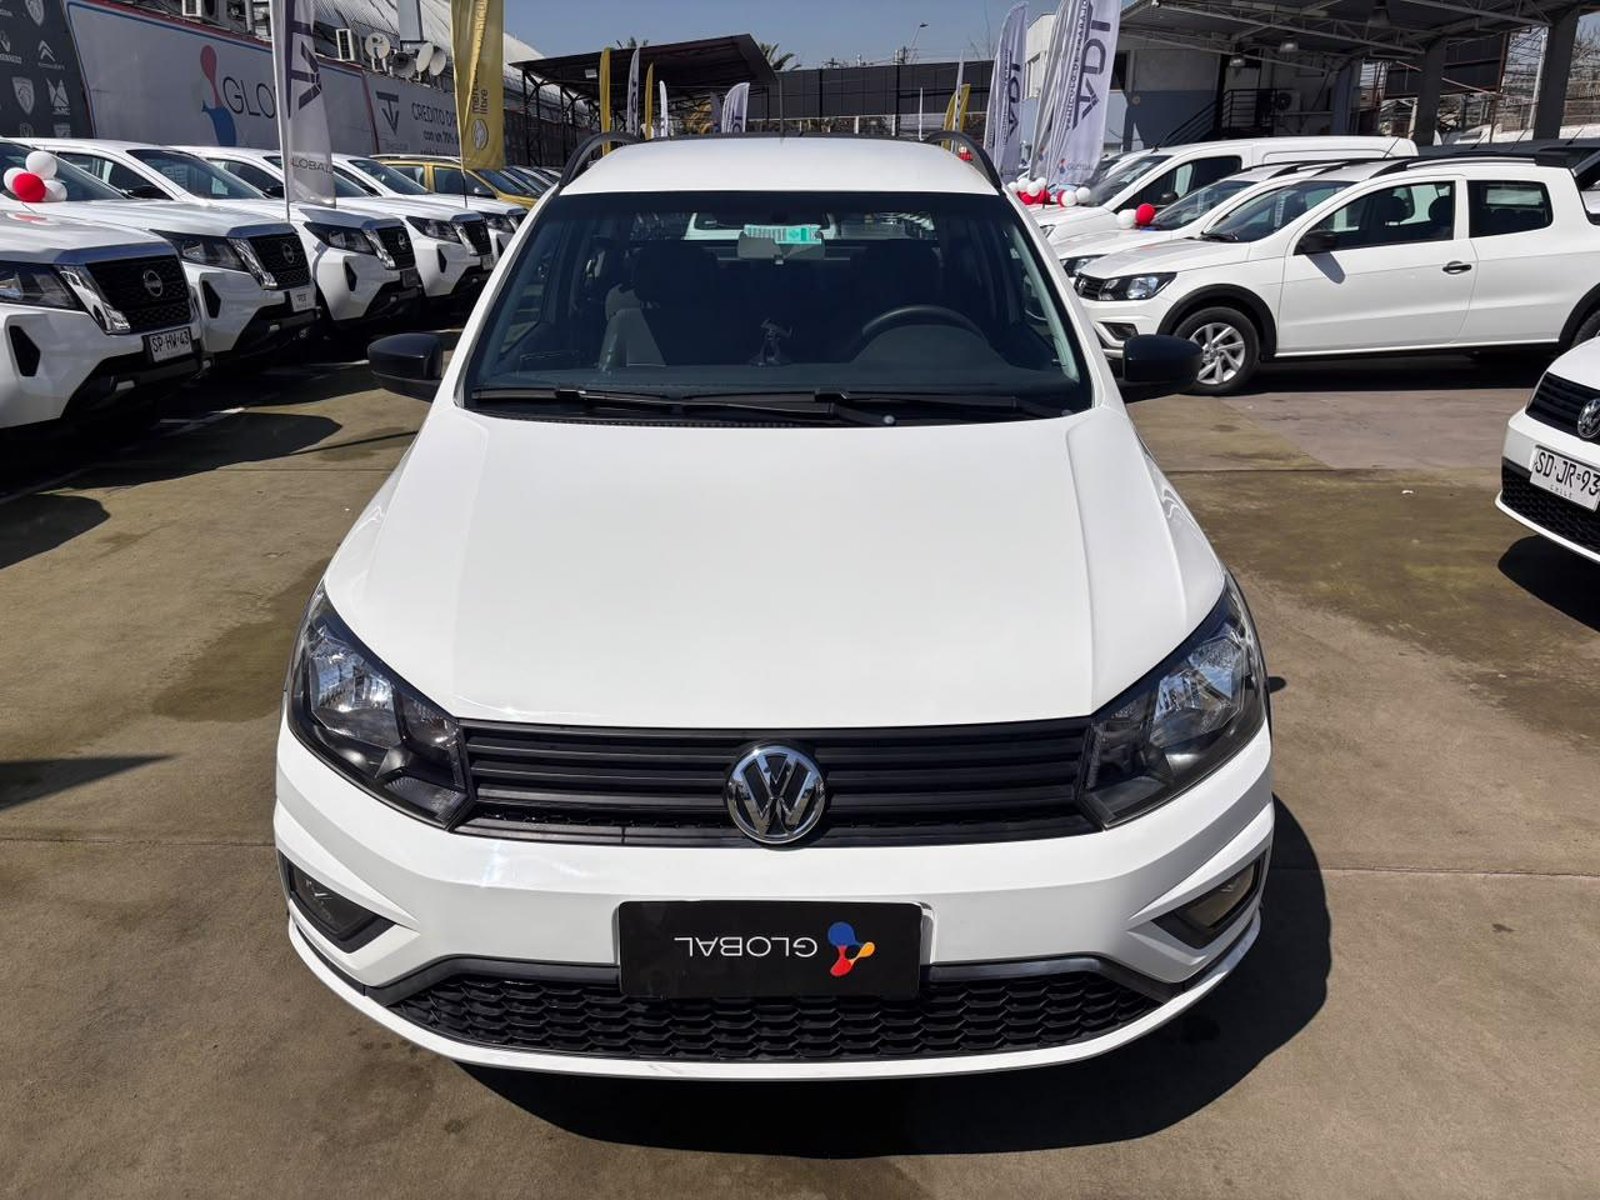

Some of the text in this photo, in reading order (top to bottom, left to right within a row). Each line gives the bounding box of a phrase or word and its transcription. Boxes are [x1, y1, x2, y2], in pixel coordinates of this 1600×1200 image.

[223, 76, 276, 119] GLO
[291, 157, 334, 174] LOBAL
[673, 935, 818, 958] GLOBAL
